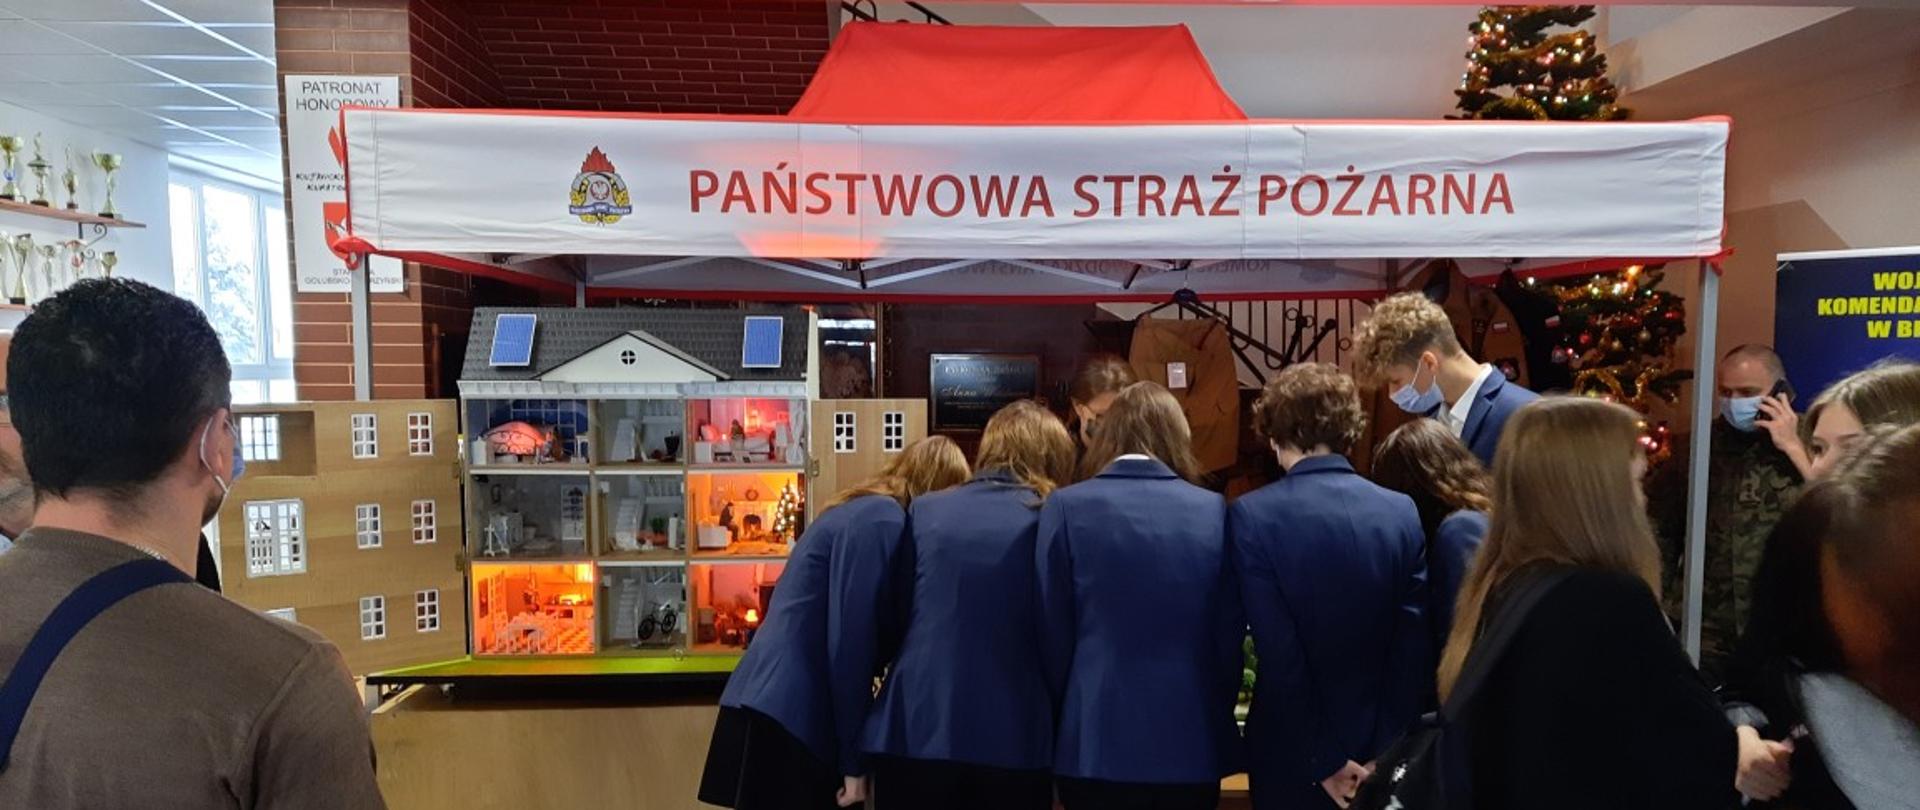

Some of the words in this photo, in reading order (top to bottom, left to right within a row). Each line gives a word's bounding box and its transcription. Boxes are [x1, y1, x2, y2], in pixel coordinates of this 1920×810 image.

[302, 81, 381, 94] PATRONAT
[689, 162, 1054, 218] PAŃSTWOWA
[1073, 165, 1241, 217] STRAŻ
[1258, 165, 1515, 217] POŻARNA
[1867, 321, 1892, 338] W
